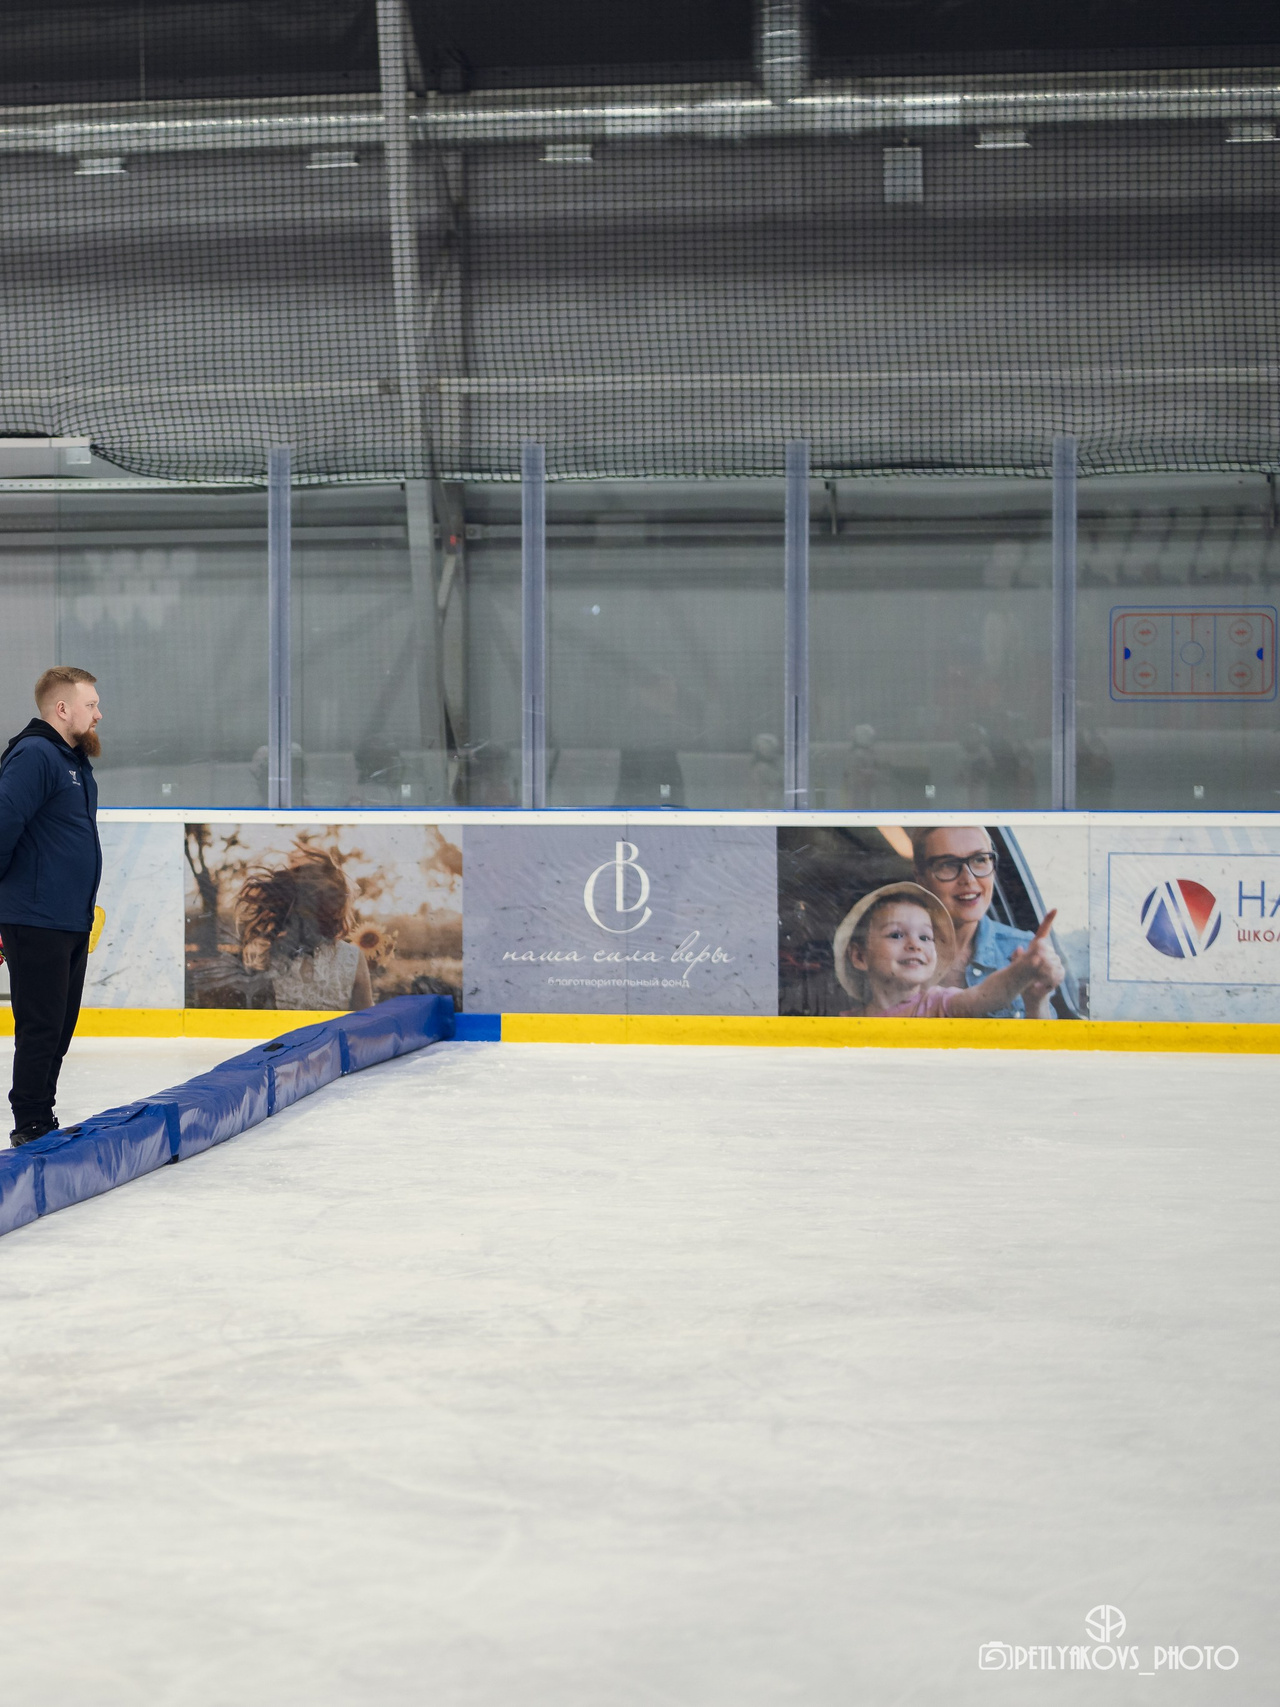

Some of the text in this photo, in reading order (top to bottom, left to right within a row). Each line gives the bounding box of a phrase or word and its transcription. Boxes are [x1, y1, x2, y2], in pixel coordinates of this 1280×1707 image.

[502, 930, 736, 979] наша сила веры
[547, 976, 690, 988] благотворительный фонд
